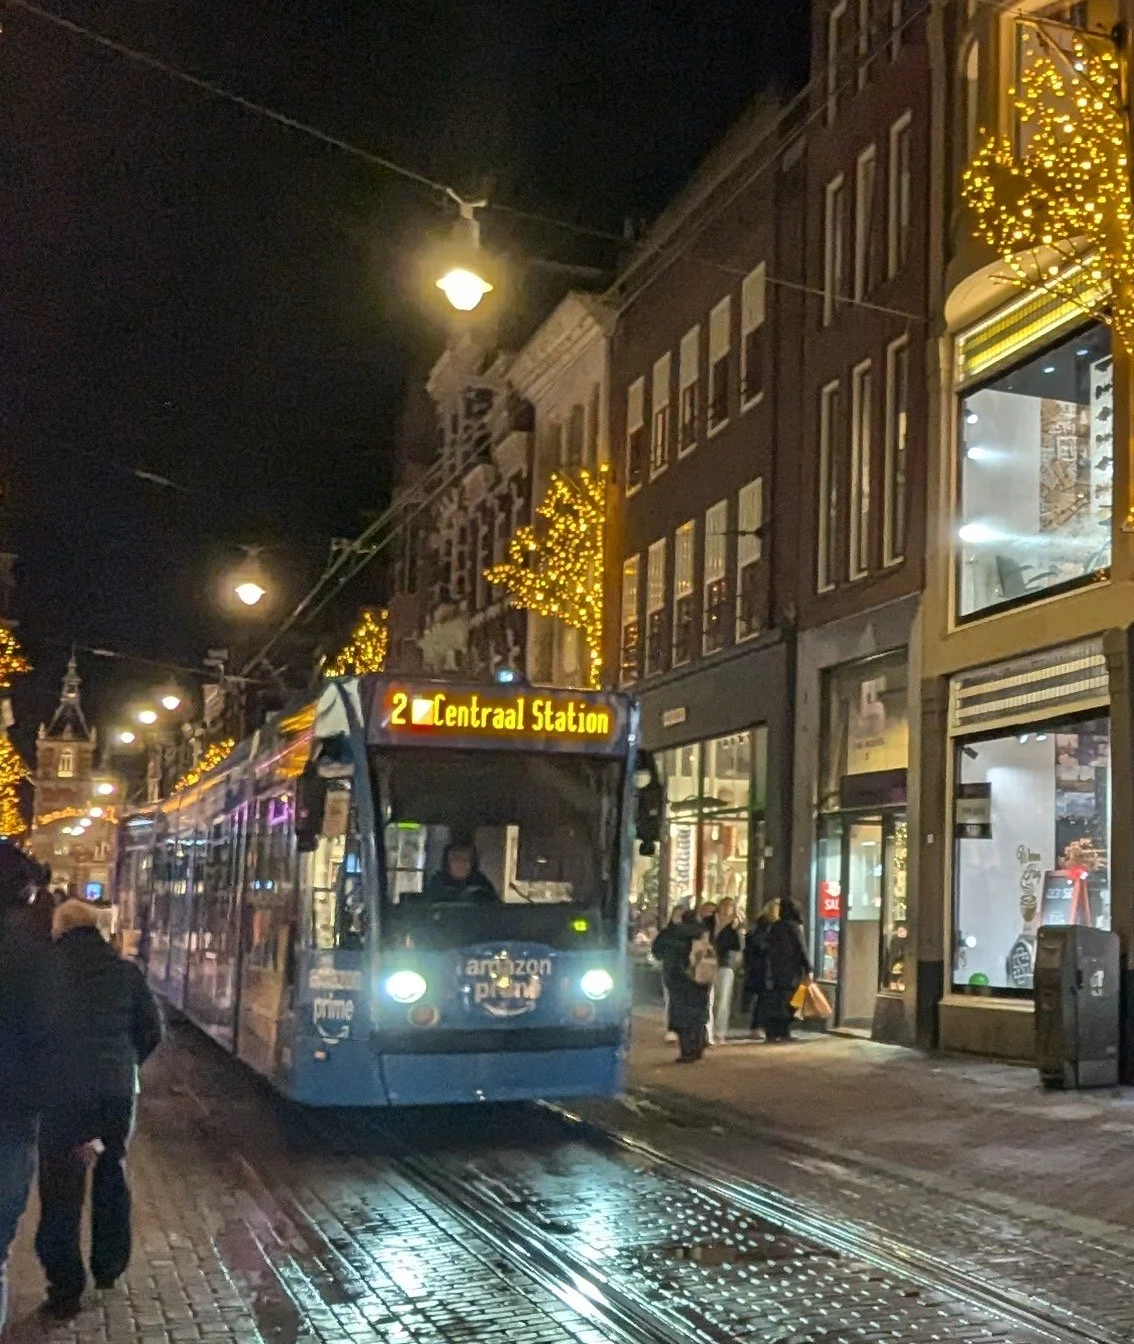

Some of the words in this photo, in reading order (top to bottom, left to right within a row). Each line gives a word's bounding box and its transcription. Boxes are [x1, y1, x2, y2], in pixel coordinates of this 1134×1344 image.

[391, 693, 408, 725] 2
[434, 693, 524, 730] Centraal
[532, 699, 609, 734] Station
[475, 983, 541, 1003] prme
